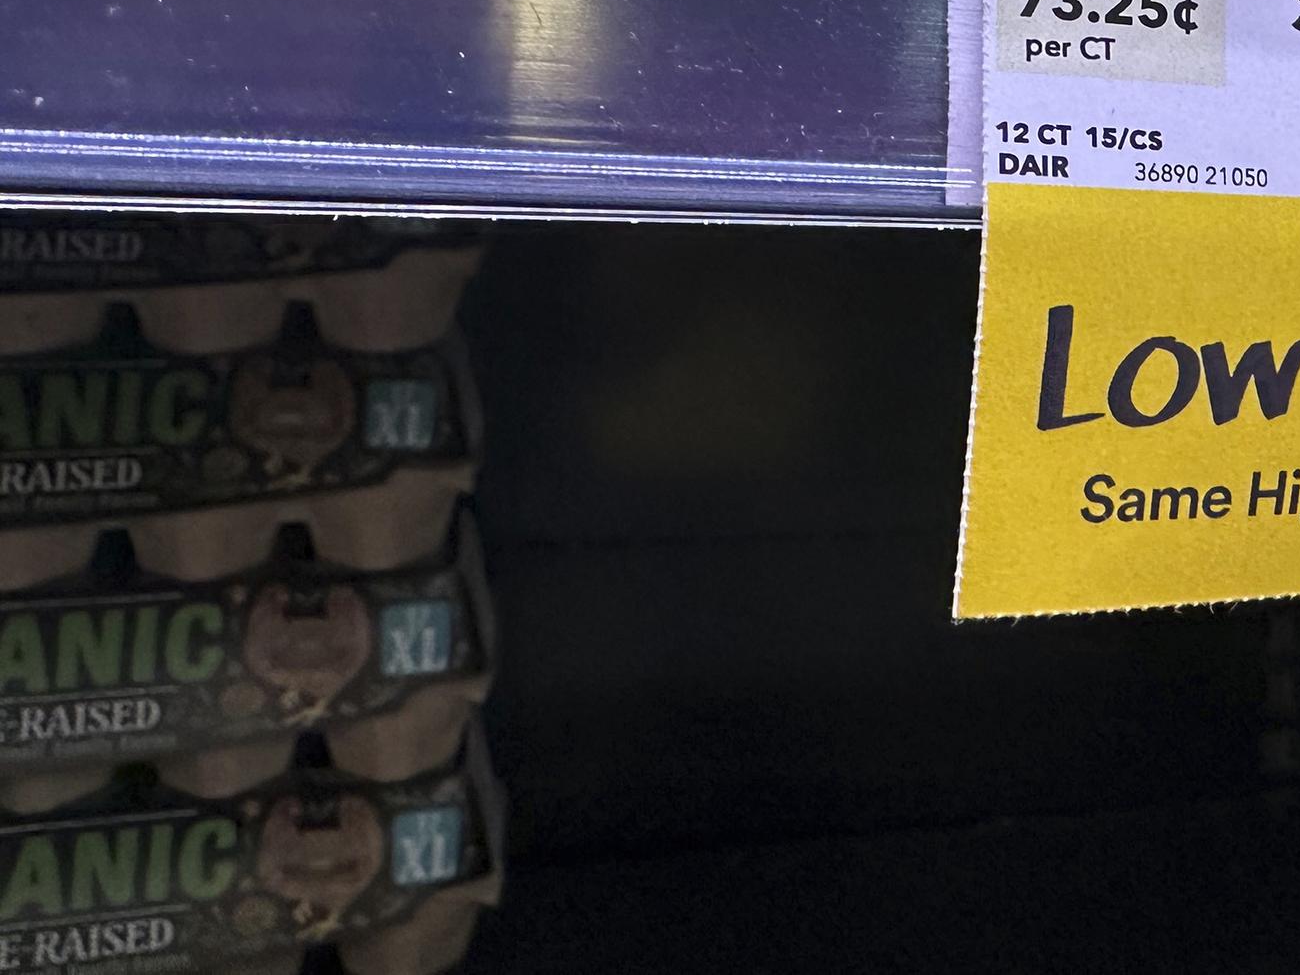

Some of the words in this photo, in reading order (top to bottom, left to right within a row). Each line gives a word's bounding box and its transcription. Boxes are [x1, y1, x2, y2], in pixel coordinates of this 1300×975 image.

[1026, 38, 1071, 62] per
[1079, 36, 1116, 61] CT
[996, 121, 1029, 144] 12
[1037, 124, 1072, 145] CT
[1086, 127, 1163, 151] 15/CS
[999, 152, 1070, 178] DAIR
[1135, 162, 1198, 184] 36890
[1205, 166, 1268, 187] 21050
[1, 231, 144, 262] RAISED
[1, 457, 144, 495] RAISED
[1080, 473, 1231, 523] Same
[18, 698, 162, 742] RAISED
[33, 917, 175, 967] RAISED
